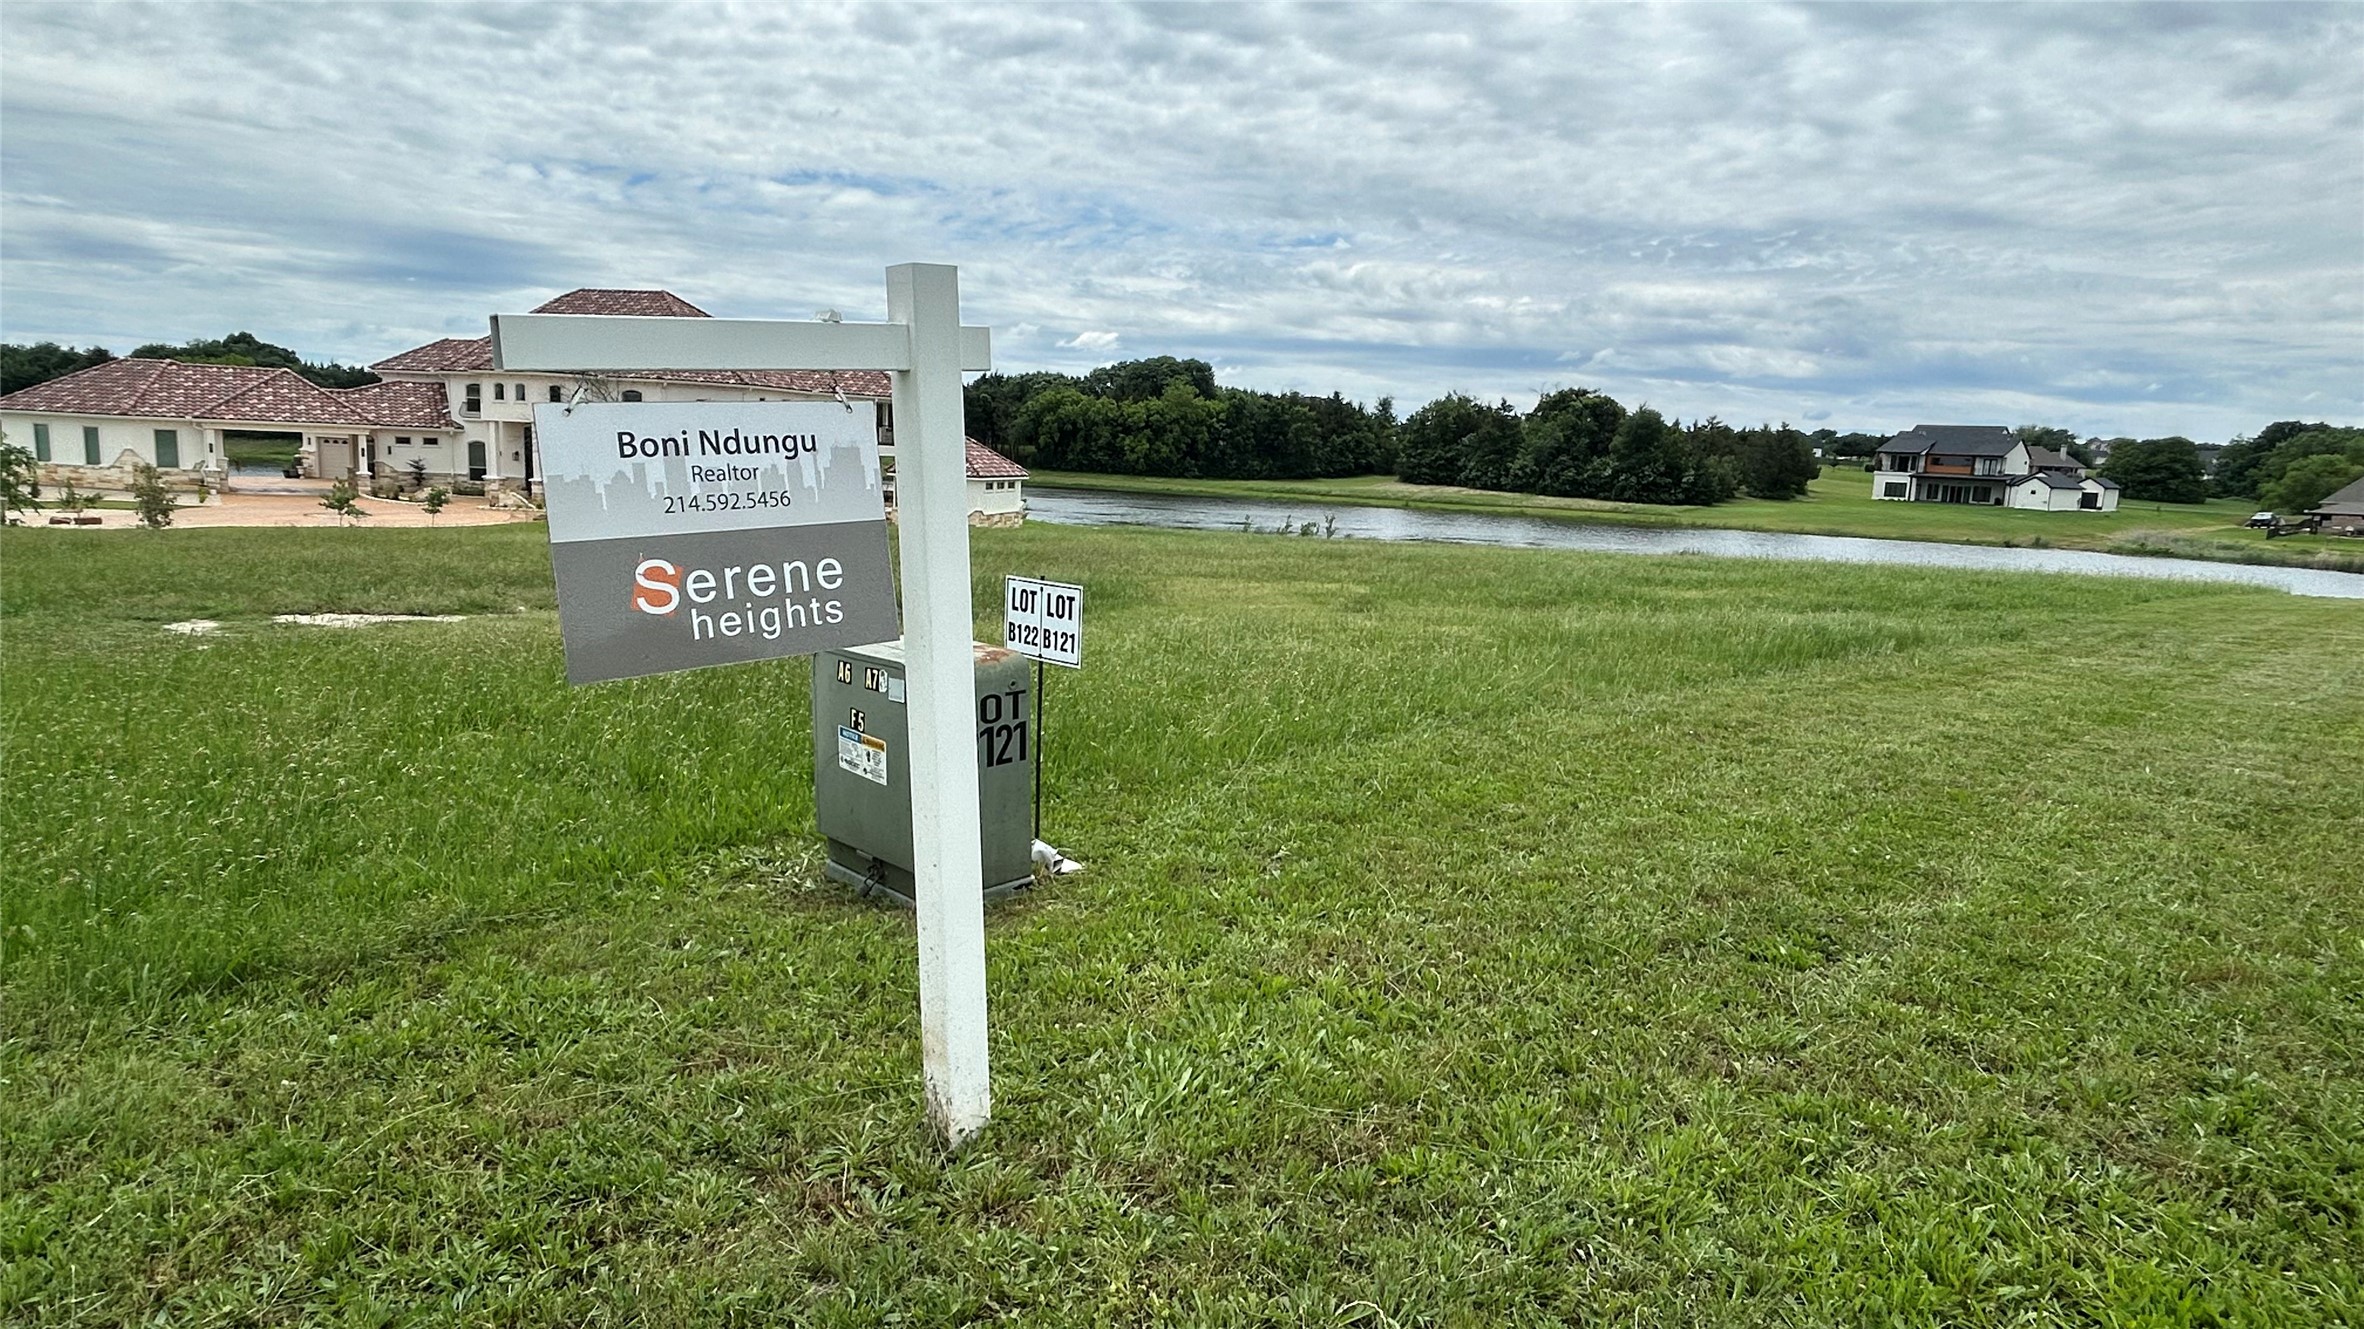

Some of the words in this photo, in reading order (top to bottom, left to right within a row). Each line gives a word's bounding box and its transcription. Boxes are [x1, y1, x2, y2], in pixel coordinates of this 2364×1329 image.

[617, 430, 690, 459] Boni
[700, 428, 818, 461] Ndungu
[691, 463, 760, 483] Realtor
[664, 490, 792, 514] 214.592.5456
[634, 557, 844, 615] Serene
[1012, 587, 1037, 614] LOT
[1047, 593, 1075, 621] LOT
[691, 598, 844, 640] heights
[1008, 621, 1039, 647] B122
[1043, 628, 1075, 654] B121
[838, 661, 851, 684] A6
[865, 668, 888, 693] A7
[980, 690, 1027, 724] OT
[980, 721, 1027, 768] 121
